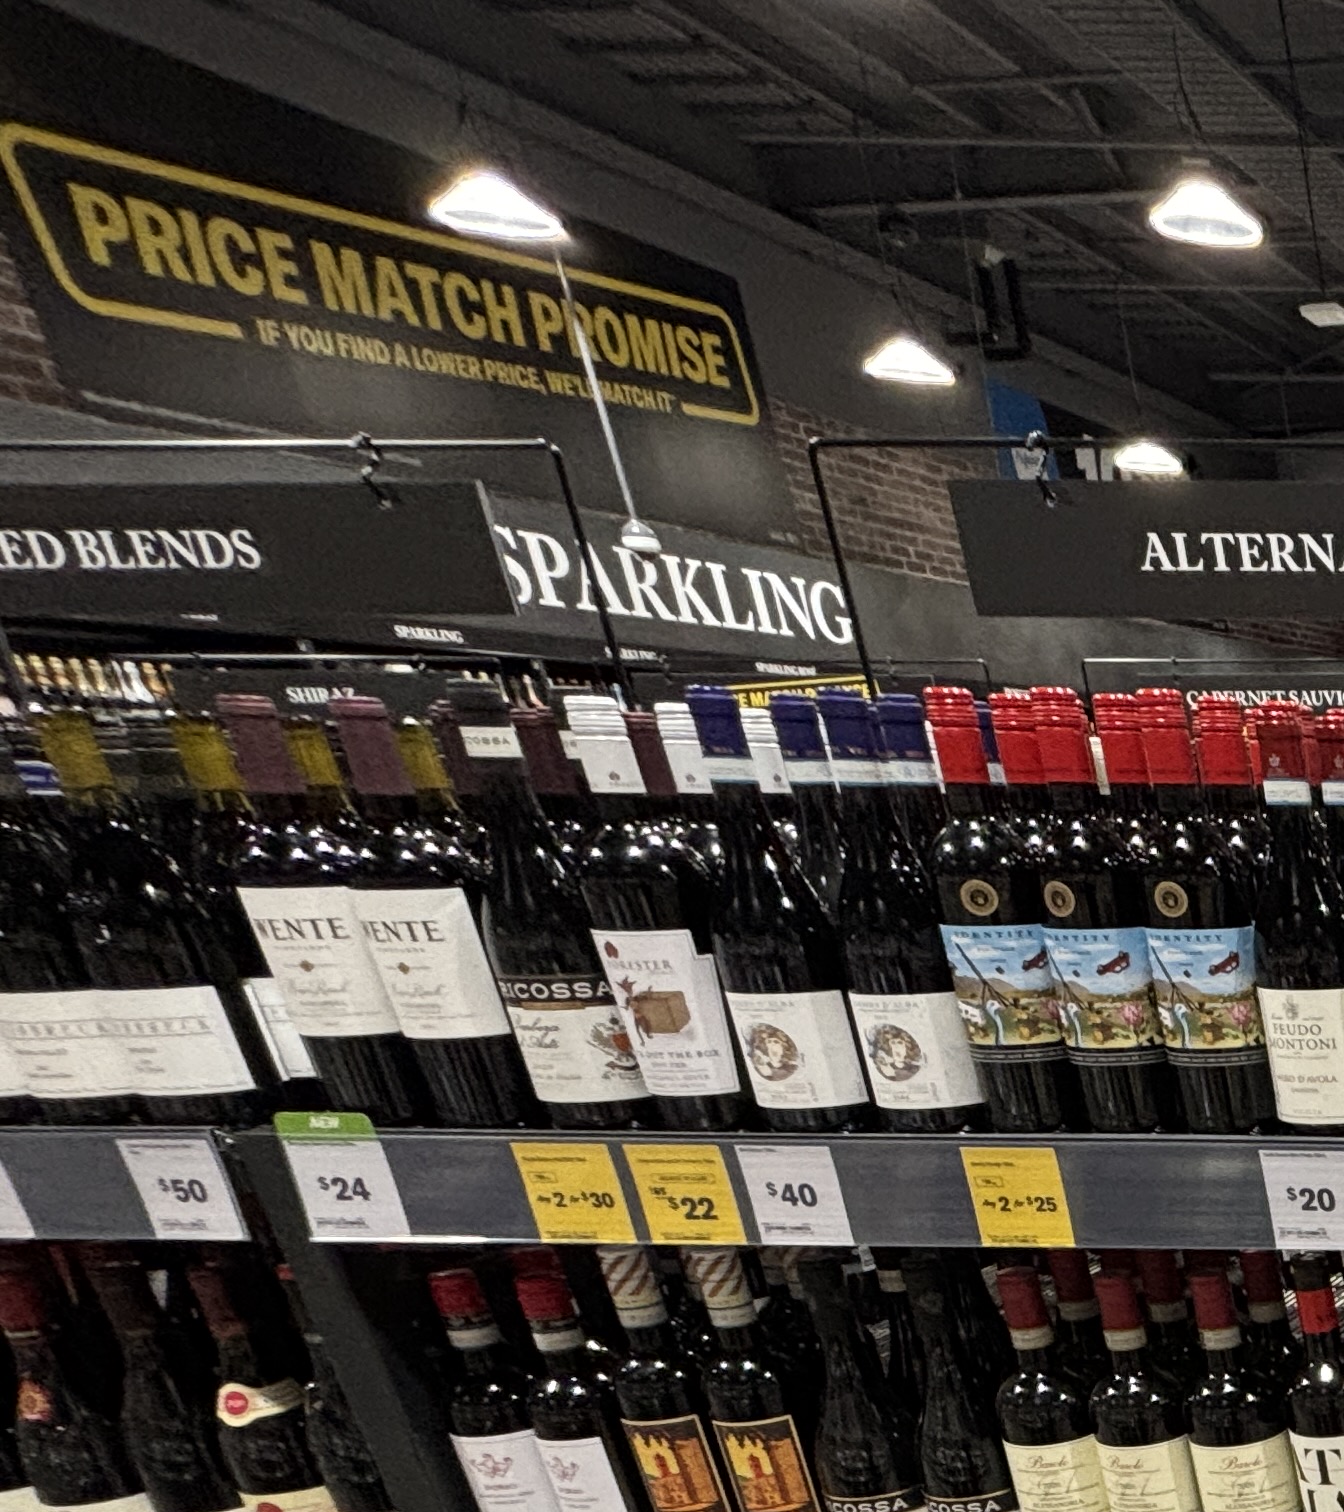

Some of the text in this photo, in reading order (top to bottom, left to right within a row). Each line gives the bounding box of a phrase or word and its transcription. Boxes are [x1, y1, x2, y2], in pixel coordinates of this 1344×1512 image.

[66, 182, 731, 389] PRICE MATCH PROMISE
[255, 317, 282, 347] IF
[287, 324, 336, 357] YOU
[339, 332, 391, 366] FIND
[396, 343, 408, 368] A
[411, 346, 481, 380] LOWER
[76, 529, 262, 572] BLENDS
[492, 524, 854, 645] SPARKLING
[953, 927, 1036, 942] IDENTITY
[1272, 1022, 1323, 1038] FEUDO
[1269, 1037, 1339, 1053] MONTONI
[158, 1178, 208, 1204] $50
[317, 1174, 371, 1203] $24
[766, 1181, 818, 1208] $40
[1287, 1186, 1336, 1213] $20
[668, 1194, 719, 1222] $22
